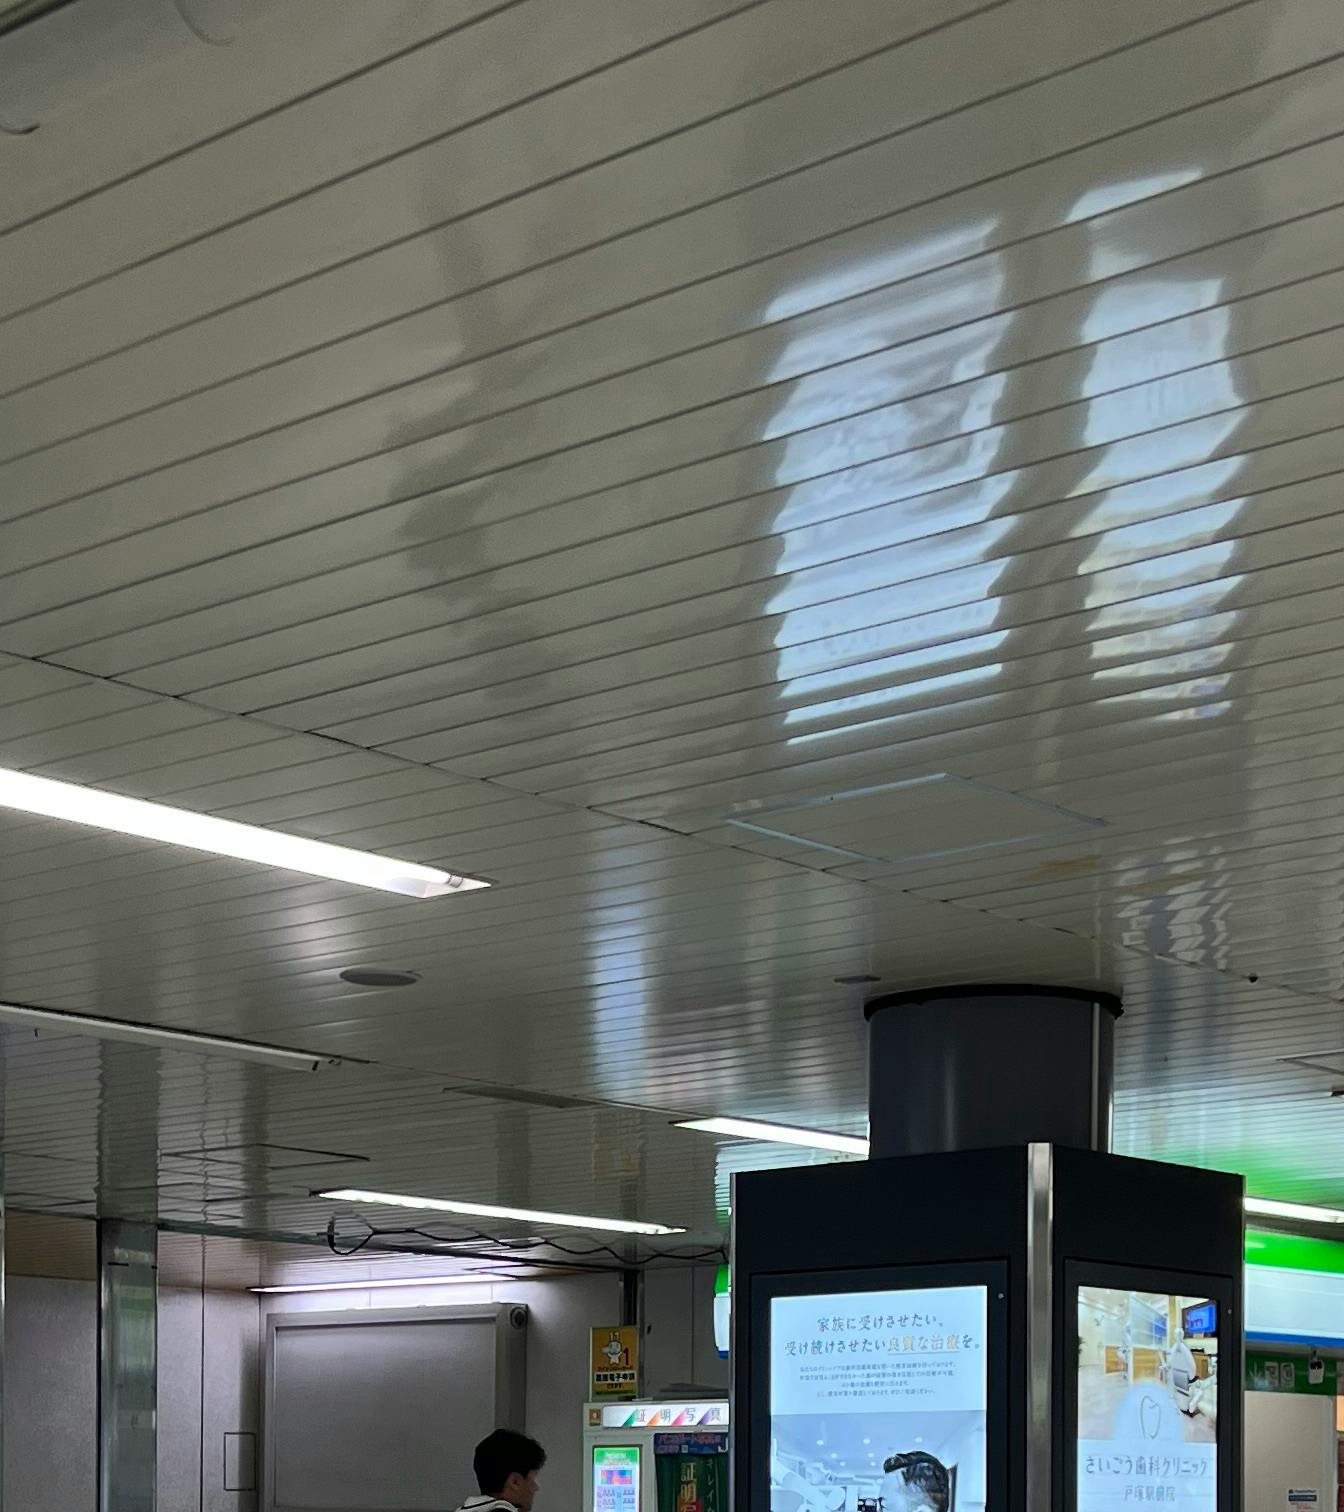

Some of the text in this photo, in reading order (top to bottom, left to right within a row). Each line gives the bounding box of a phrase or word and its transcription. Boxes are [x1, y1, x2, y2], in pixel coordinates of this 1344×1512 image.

[1086, 1455, 1208, 1476] さいごう歯科クリニック
